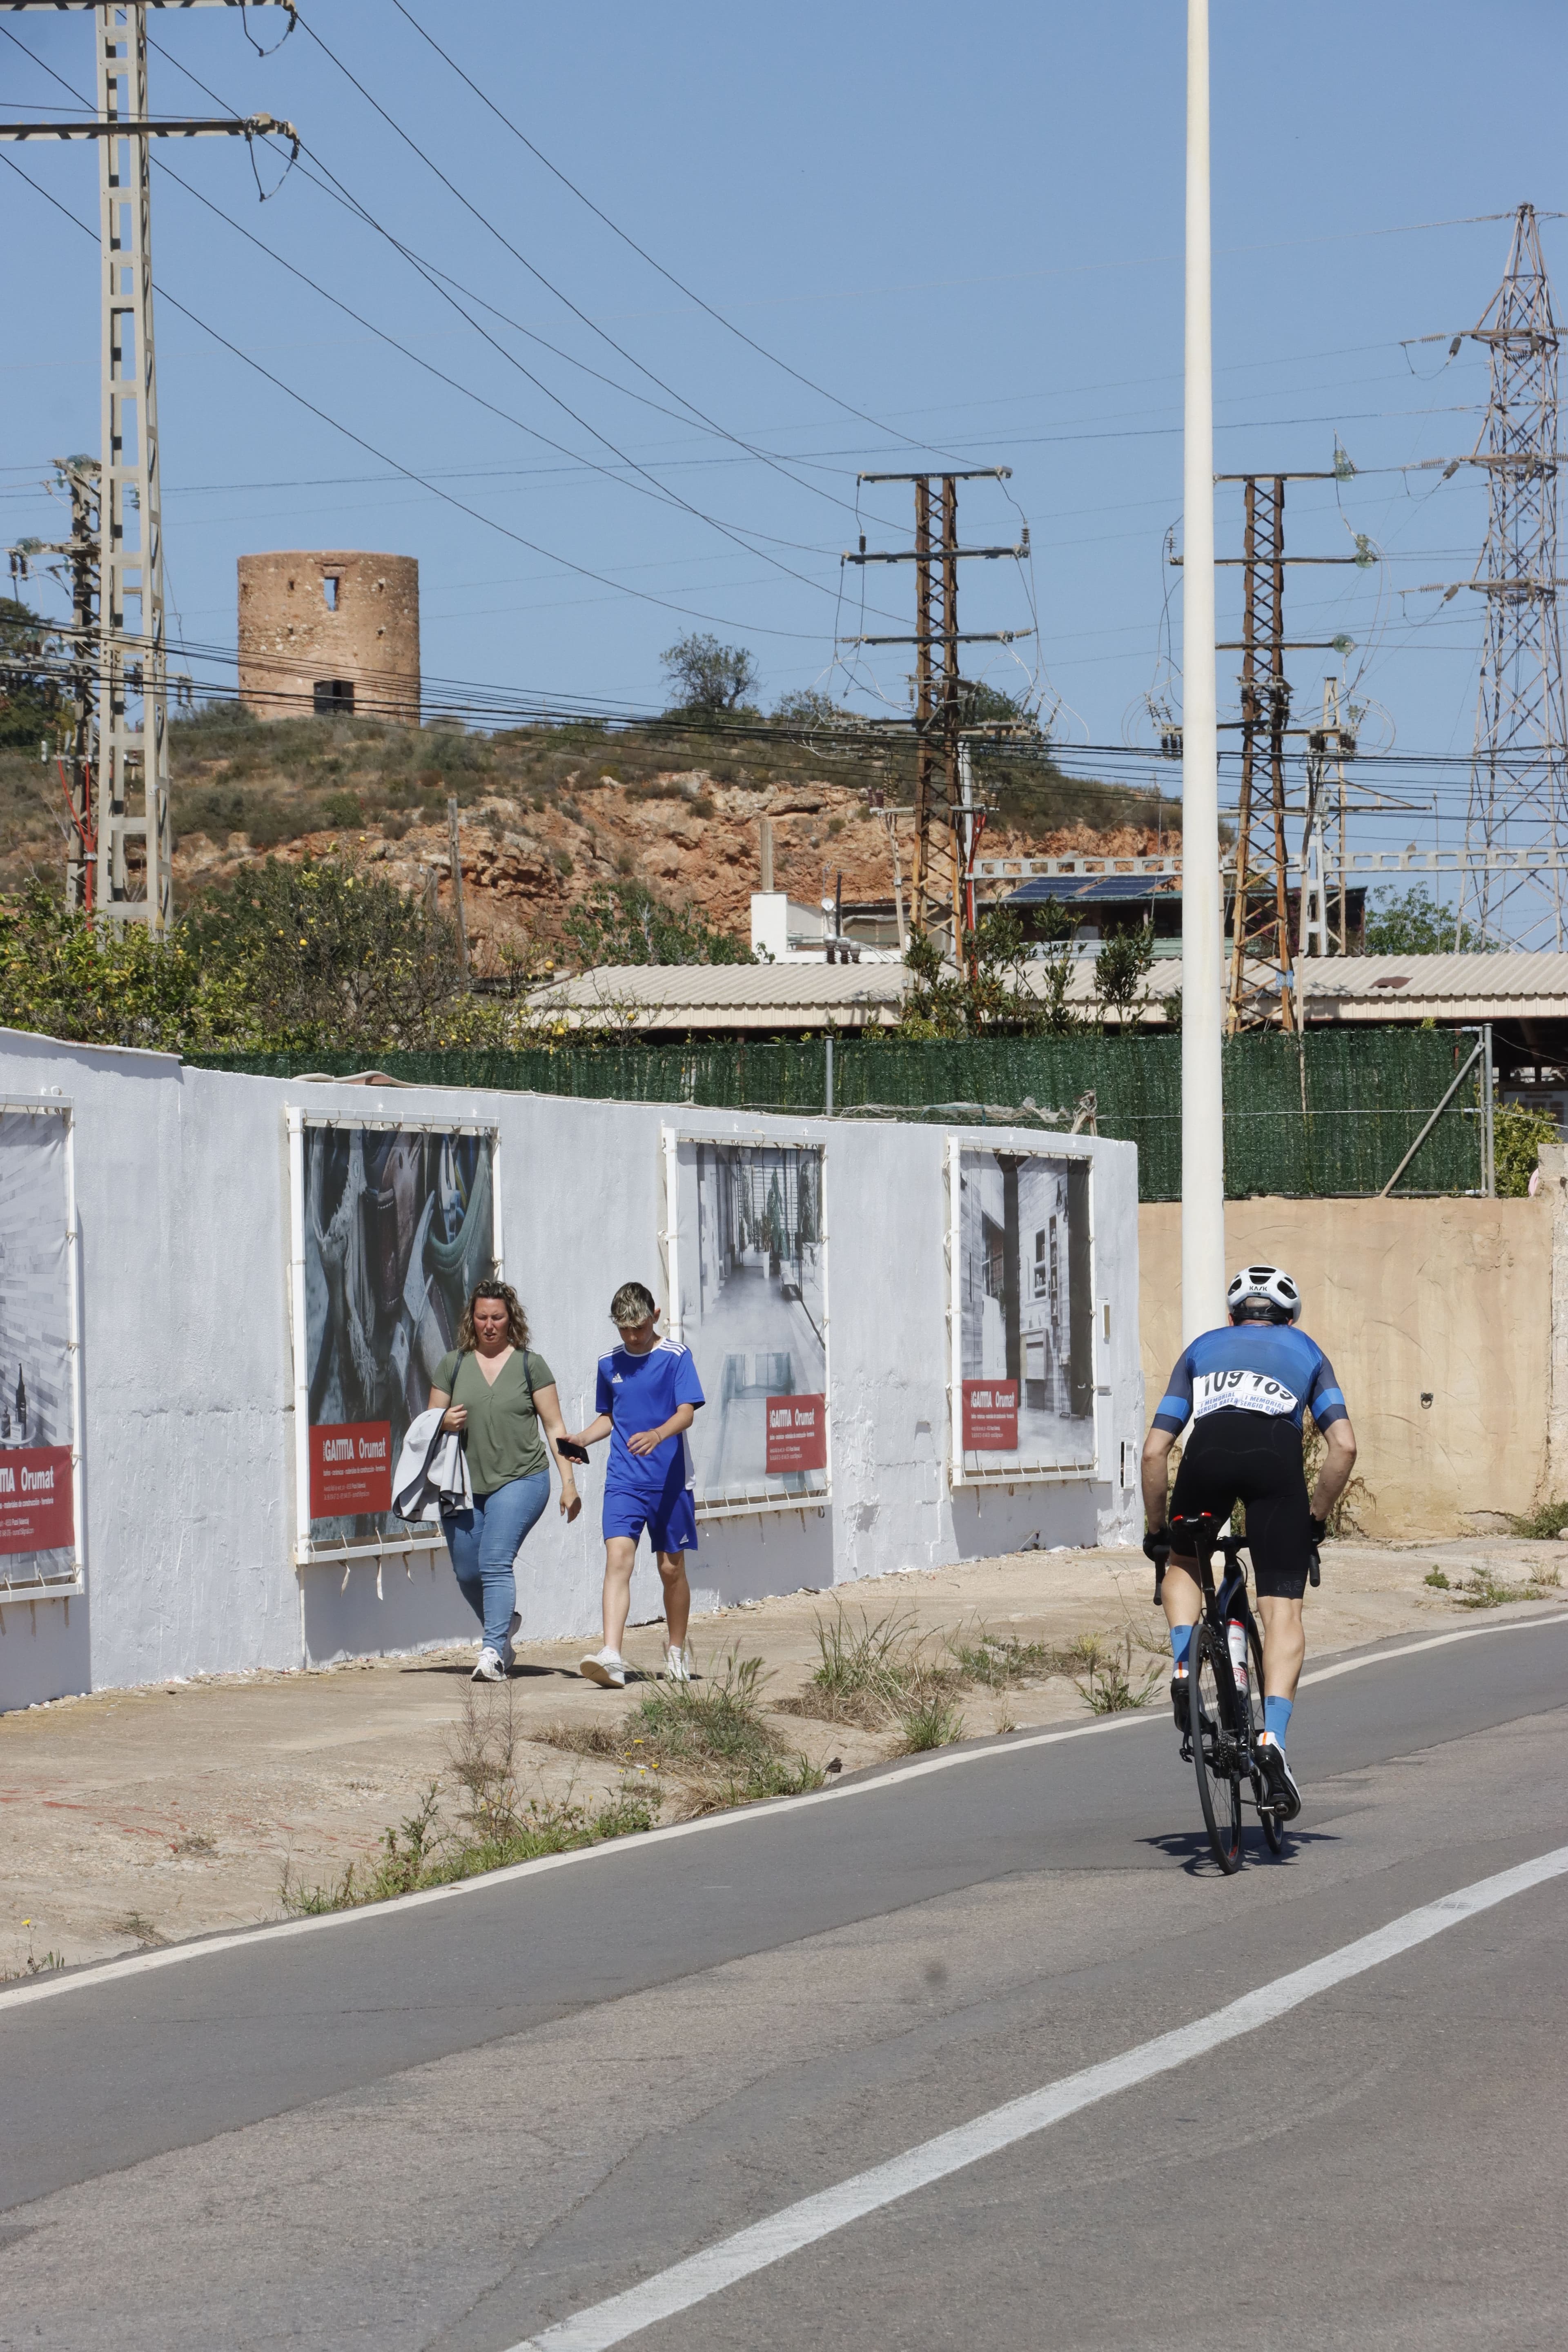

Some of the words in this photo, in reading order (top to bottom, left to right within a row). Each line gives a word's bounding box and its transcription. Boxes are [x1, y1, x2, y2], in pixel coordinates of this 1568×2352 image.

[996, 1391, 1014, 1408] Orumat
[1205, 1392, 1235, 1405] MEMORIAL
[1240, 1401, 1263, 1409] SERGIO
[1250, 1396, 1285, 1411] MEMORIAL
[795, 1408, 815, 1426] Orumat
[1197, 1403, 1217, 1415] SERGIO
[325, 1439, 354, 1461] GAMMA
[359, 1437, 386, 1459] Orumat
[21, 1465, 54, 1491] Orumat
